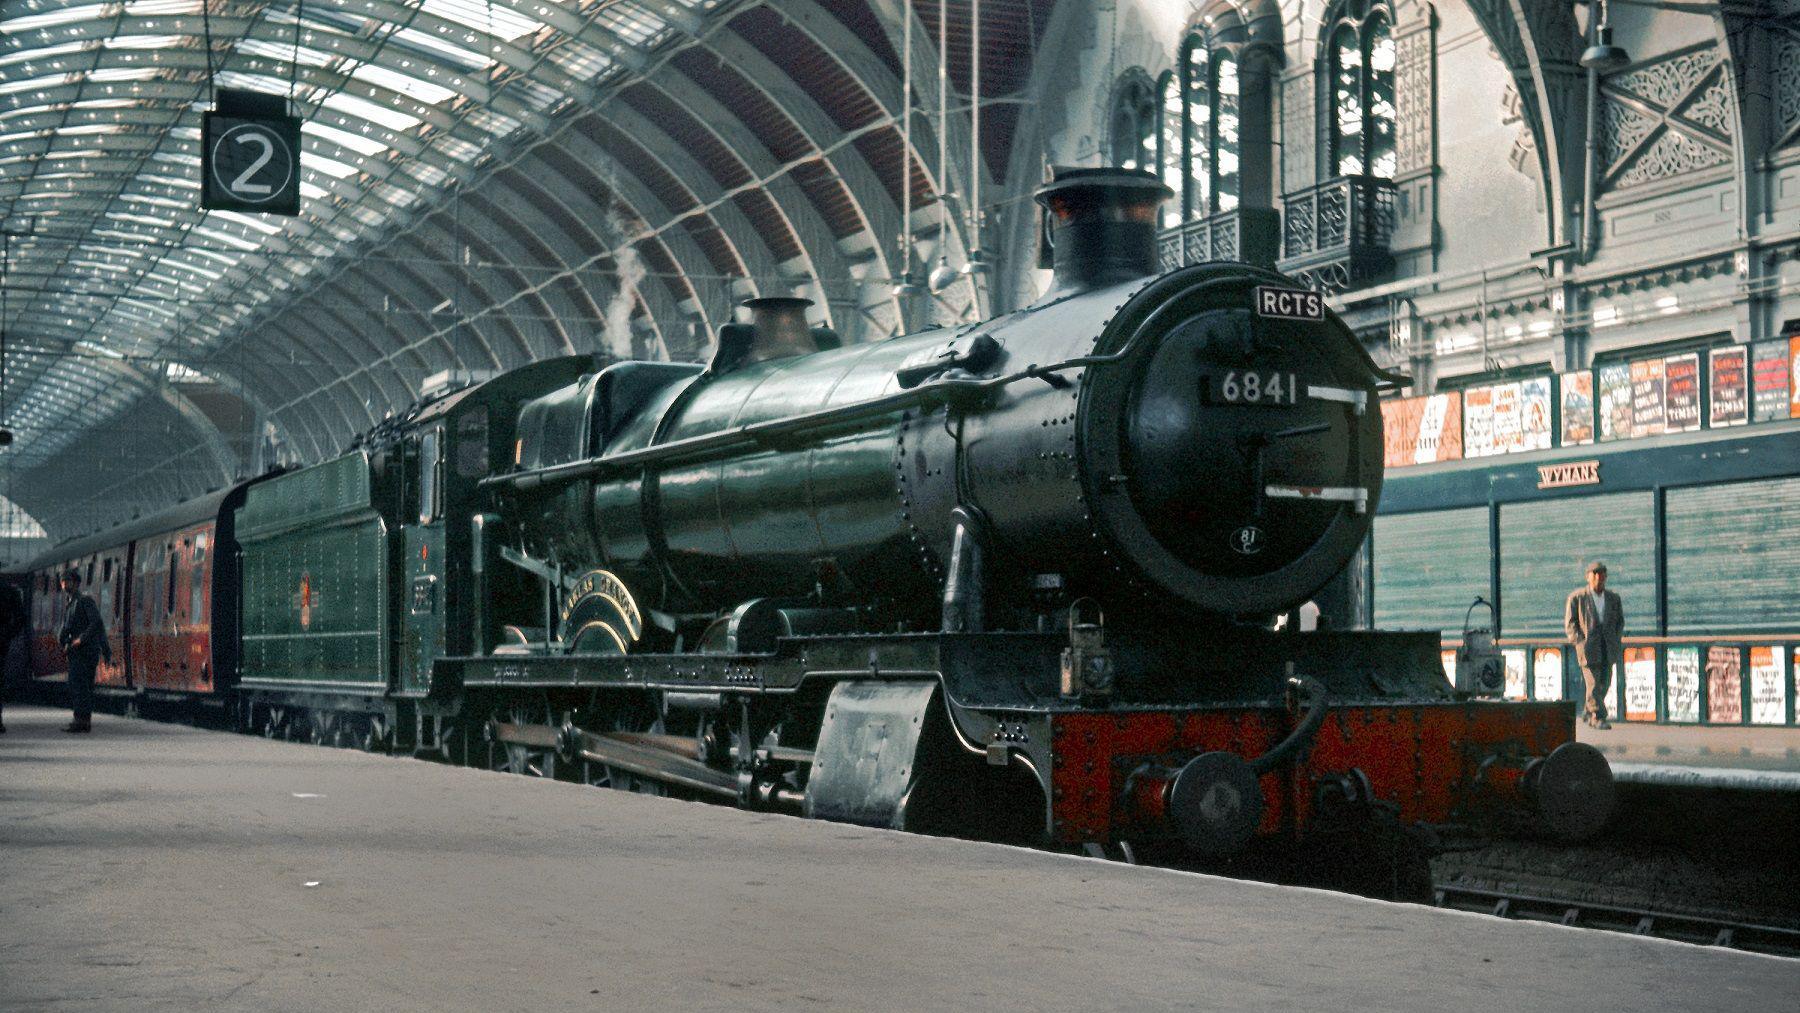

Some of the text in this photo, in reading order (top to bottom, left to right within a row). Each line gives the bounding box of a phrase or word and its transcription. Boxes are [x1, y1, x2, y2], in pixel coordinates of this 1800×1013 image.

[231, 133, 273, 194] 2
[1263, 290, 1320, 317] RCTS
[1222, 371, 1296, 405] 6841
[1668, 405, 1697, 421] TIMES
[1713, 398, 1744, 414] TIMES
[1540, 461, 1599, 486] WYMANS
[1240, 529, 1255, 543] 81
